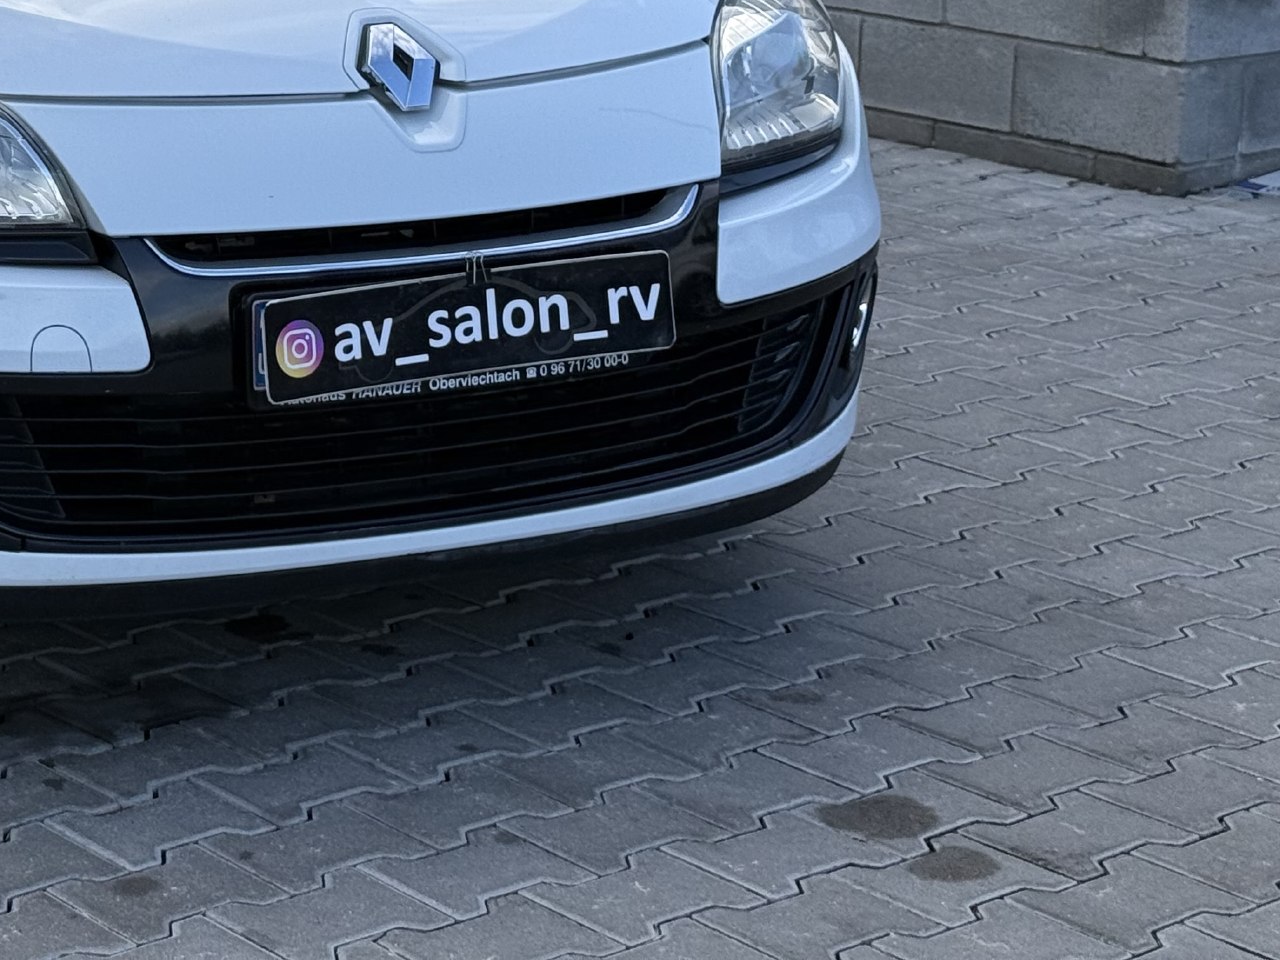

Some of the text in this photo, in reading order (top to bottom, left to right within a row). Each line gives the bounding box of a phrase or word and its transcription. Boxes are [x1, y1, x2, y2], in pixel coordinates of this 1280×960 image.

[334, 282, 661, 367] av_salon_rv
[279, 390, 347, 406] uohaus
[539, 364, 548, 377] 0
[550, 361, 565, 376] 96
[569, 357, 601, 373] 71/30
[604, 352, 629, 367] 00-0
